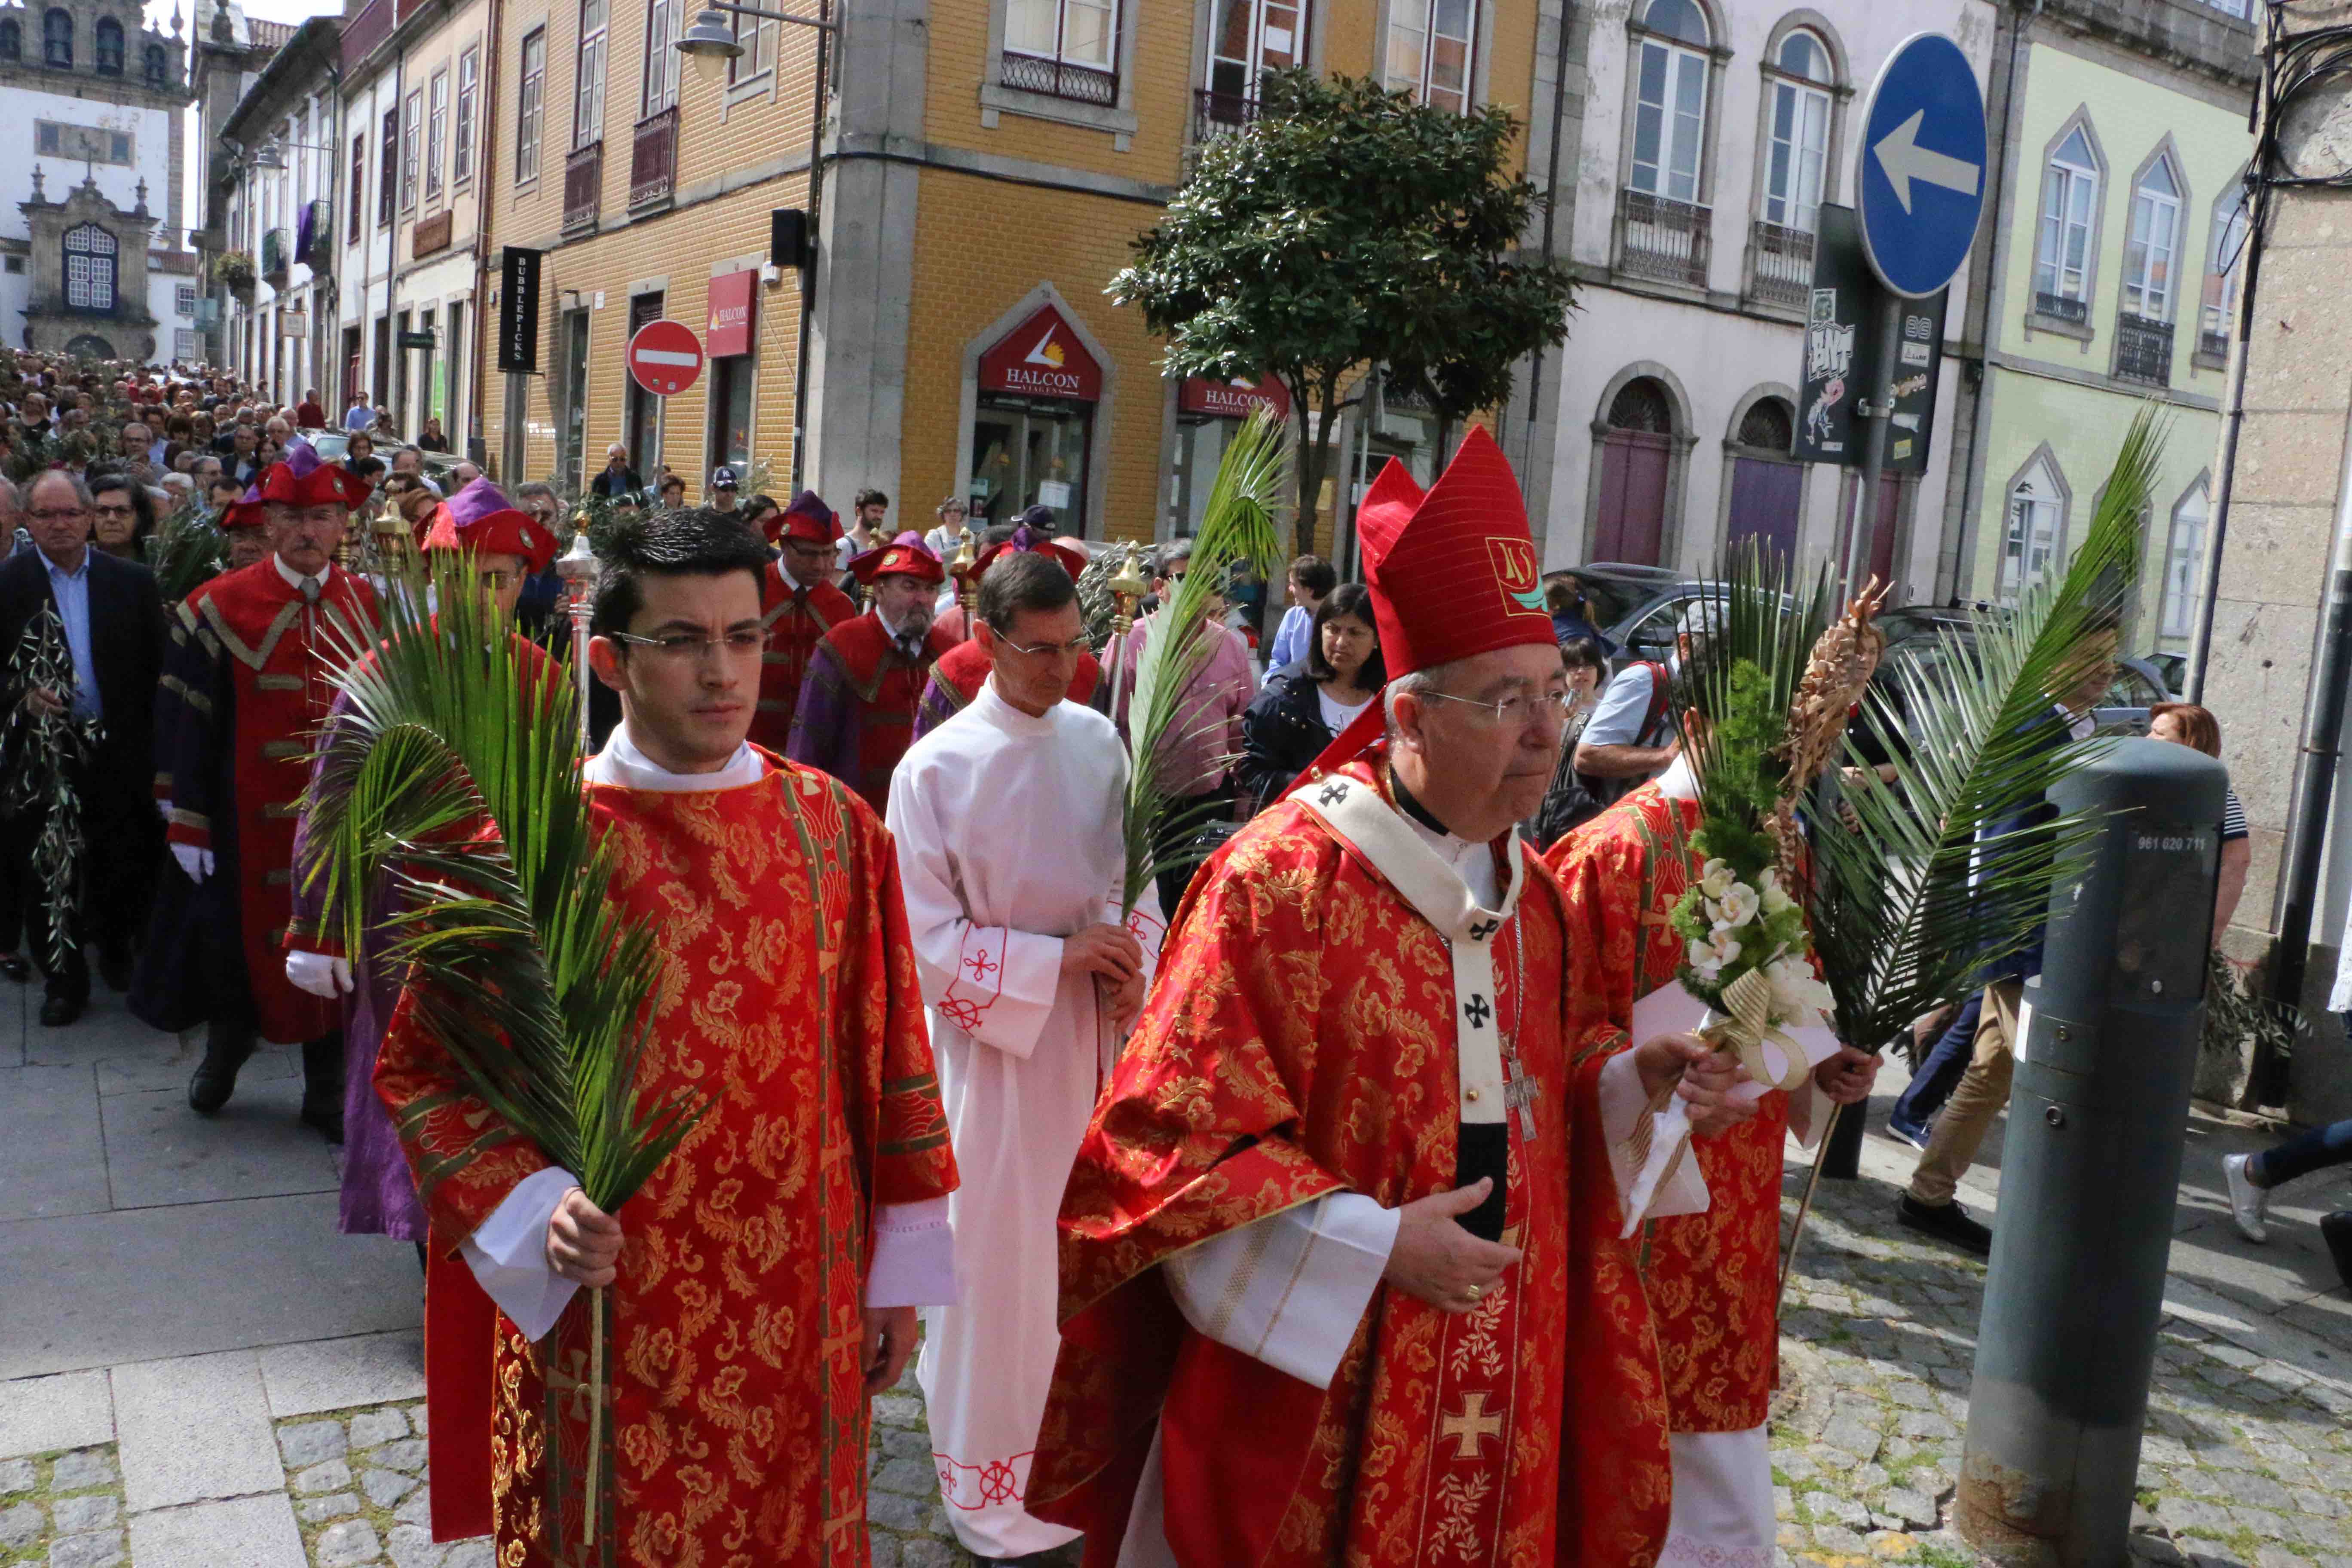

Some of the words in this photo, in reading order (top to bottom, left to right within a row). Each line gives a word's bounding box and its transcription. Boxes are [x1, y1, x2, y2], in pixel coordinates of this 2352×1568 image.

[514, 257, 527, 360] BUBBLEPICKS
[1006, 368, 1080, 389] HALCON
[1022, 384, 1066, 395] VIAGENS
[1205, 390, 1271, 409] HALCON
[2138, 836, 2158, 850] 961
[2162, 837, 2184, 851] 620
[2187, 838, 2205, 851] 711
